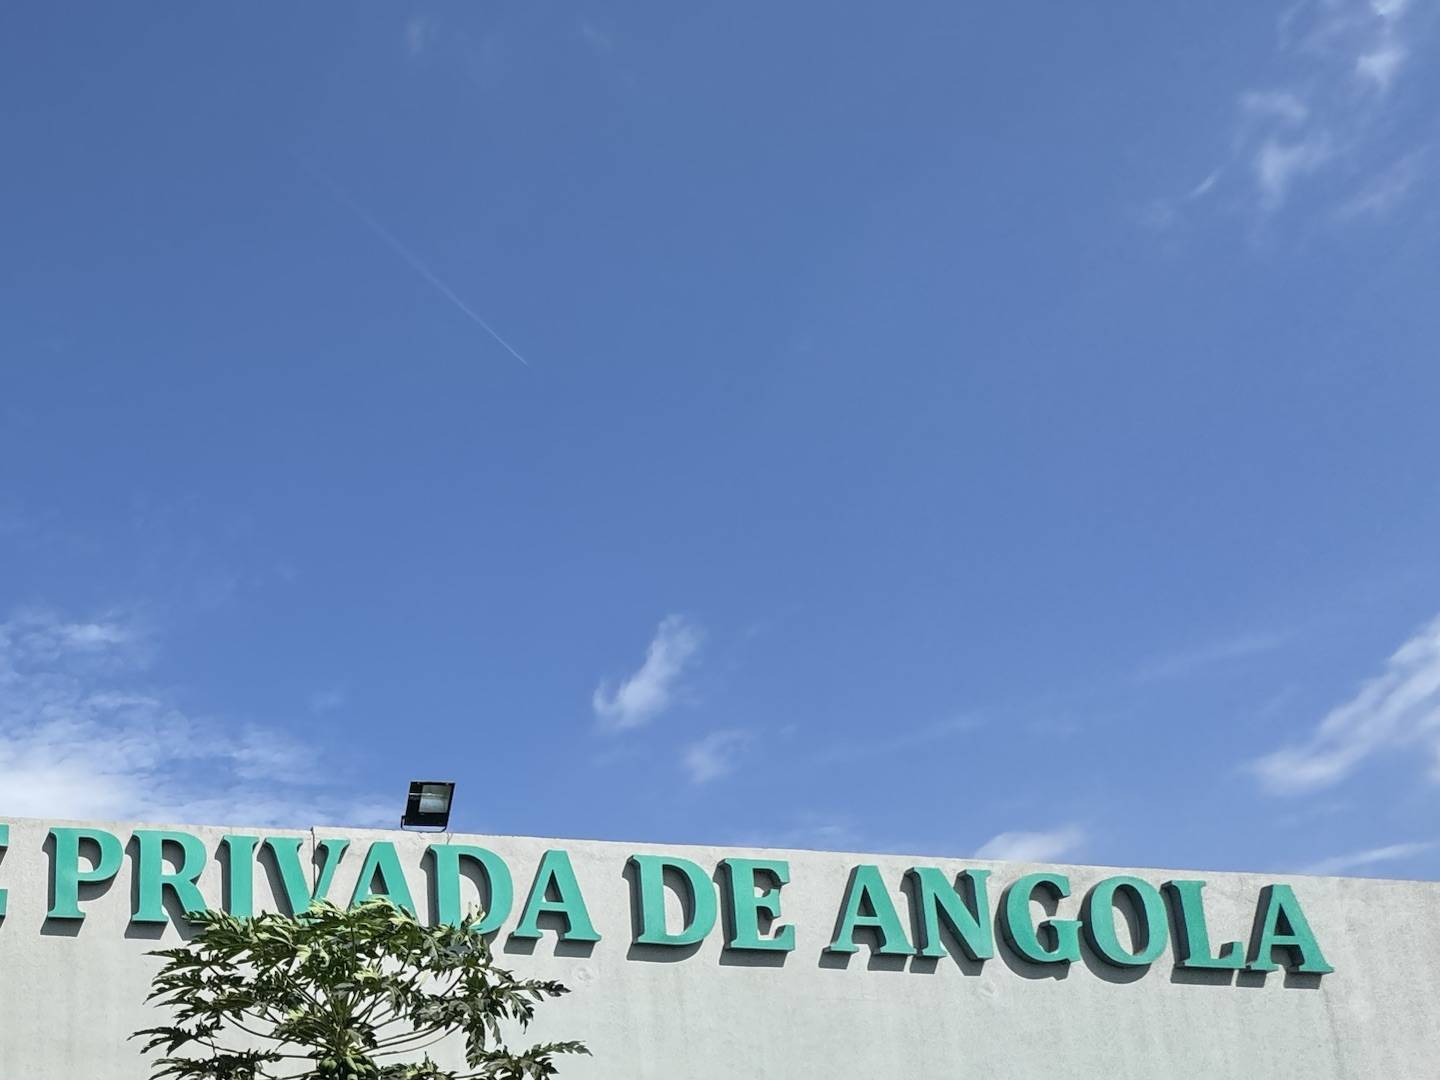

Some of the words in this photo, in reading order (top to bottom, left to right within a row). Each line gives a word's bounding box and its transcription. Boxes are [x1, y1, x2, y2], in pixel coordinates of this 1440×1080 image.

[47, 826, 602, 942] PRIVADA
[629, 854, 796, 951] DE
[827, 864, 1335, 975] ANGOLA
